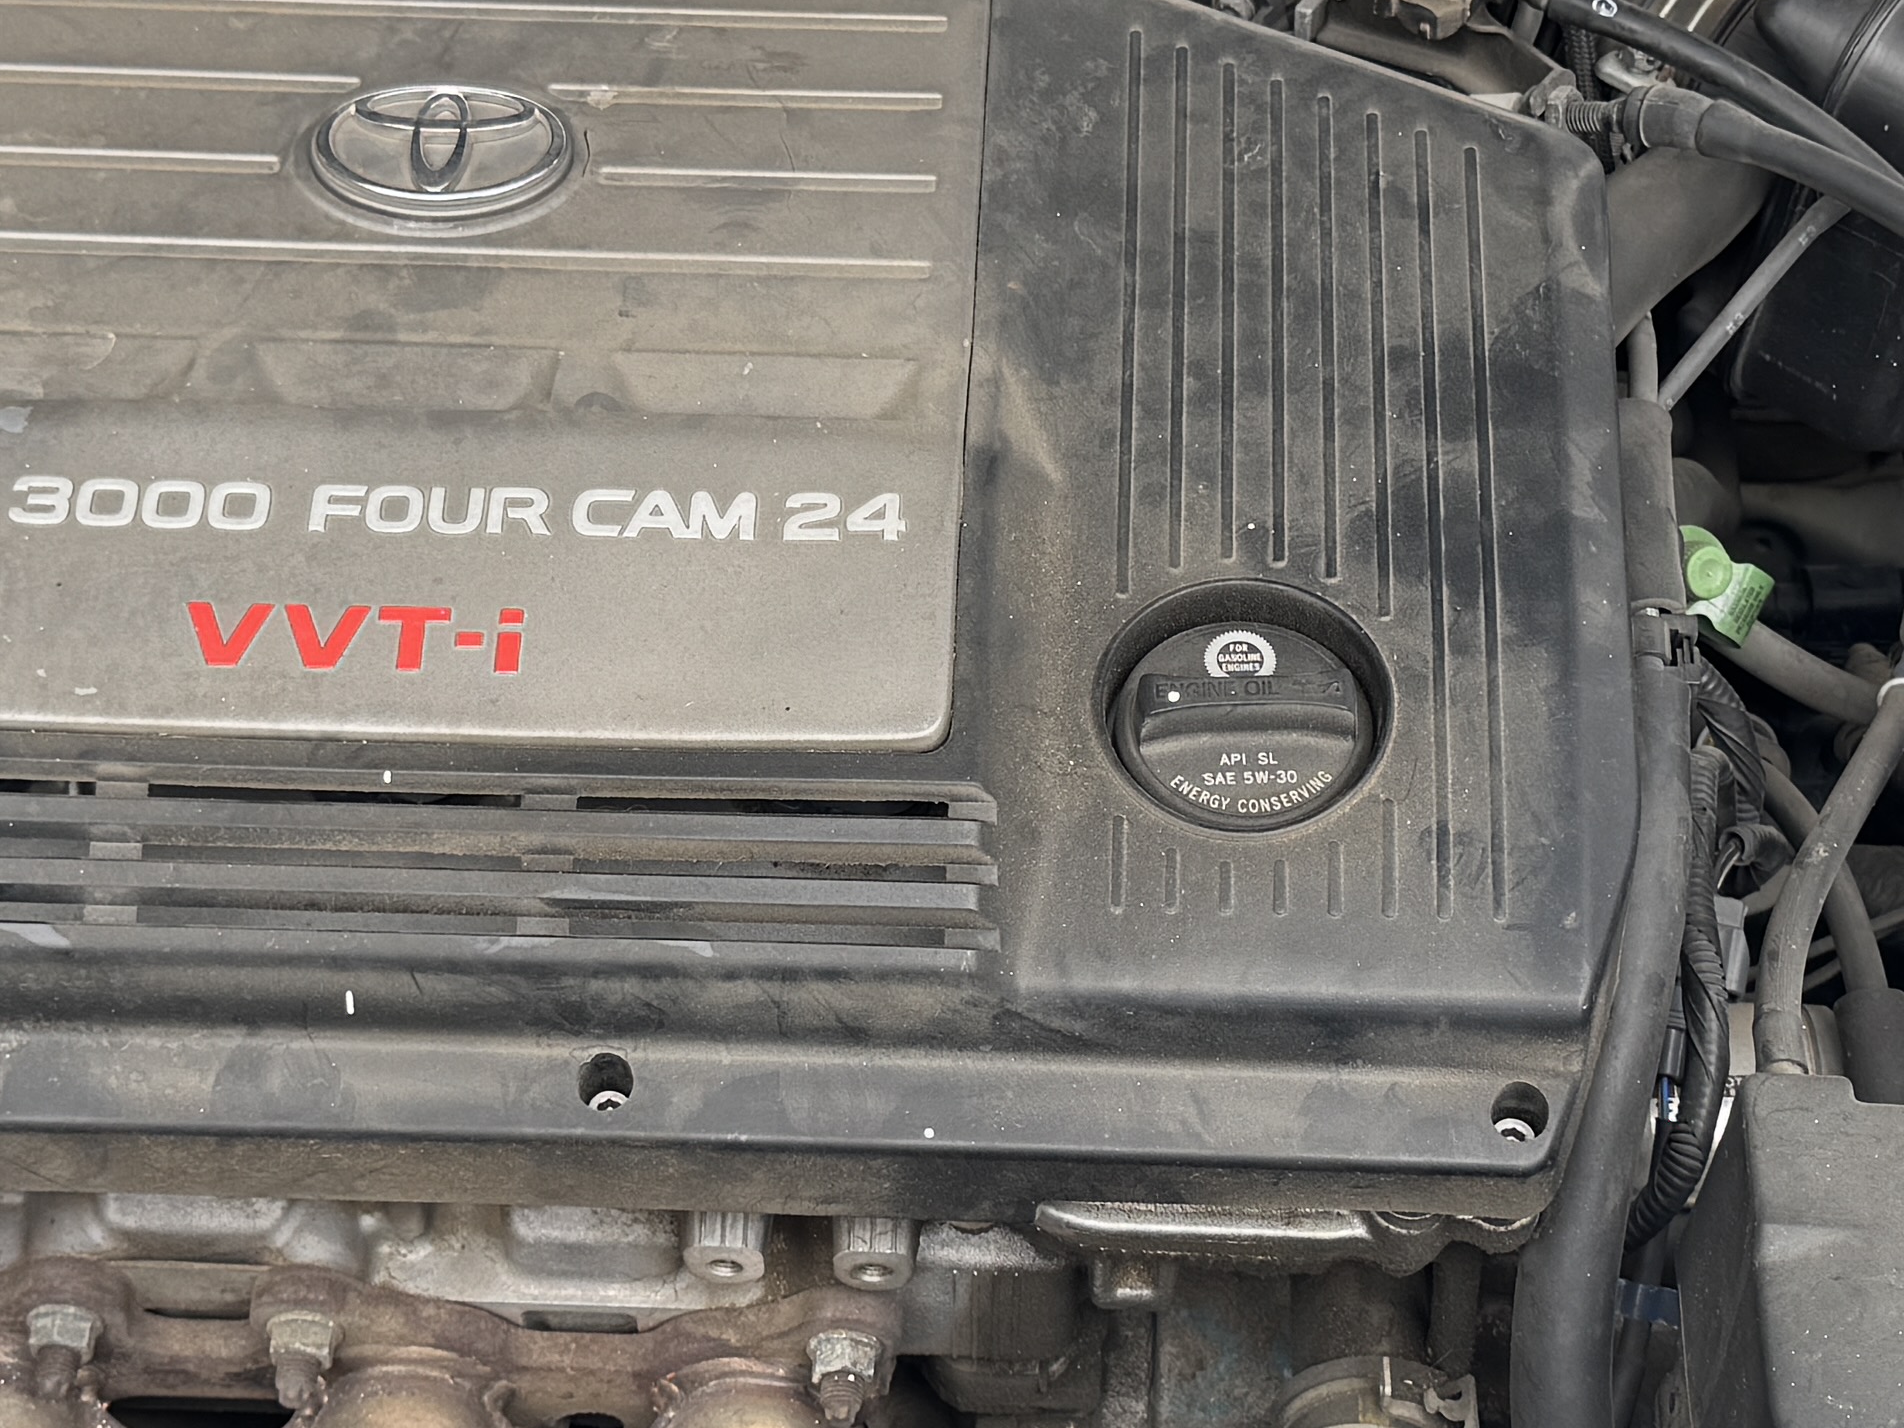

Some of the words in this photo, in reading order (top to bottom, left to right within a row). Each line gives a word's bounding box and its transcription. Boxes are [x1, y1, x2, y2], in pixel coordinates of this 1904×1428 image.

[8, 477, 272, 533] 3000
[306, 482, 551, 538] FOUR
[570, 487, 758, 543] CAM
[781, 491, 908, 545] 24
[188, 600, 528, 676] VVT-i
[1218, 653, 1262, 661] GASOLINE
[1222, 663, 1260, 671] ENGINES
[1155, 681, 1237, 700] ENGINE
[1243, 680, 1279, 696] OIL
[1219, 753, 1246, 766] API
[1257, 752, 1278, 765] SL
[1202, 772, 1236, 786] SAE
[1244, 771, 1298, 784] 5W-30
[1169, 775, 1231, 810] ENERGY
[1237, 771, 1332, 814] CONSERVING
